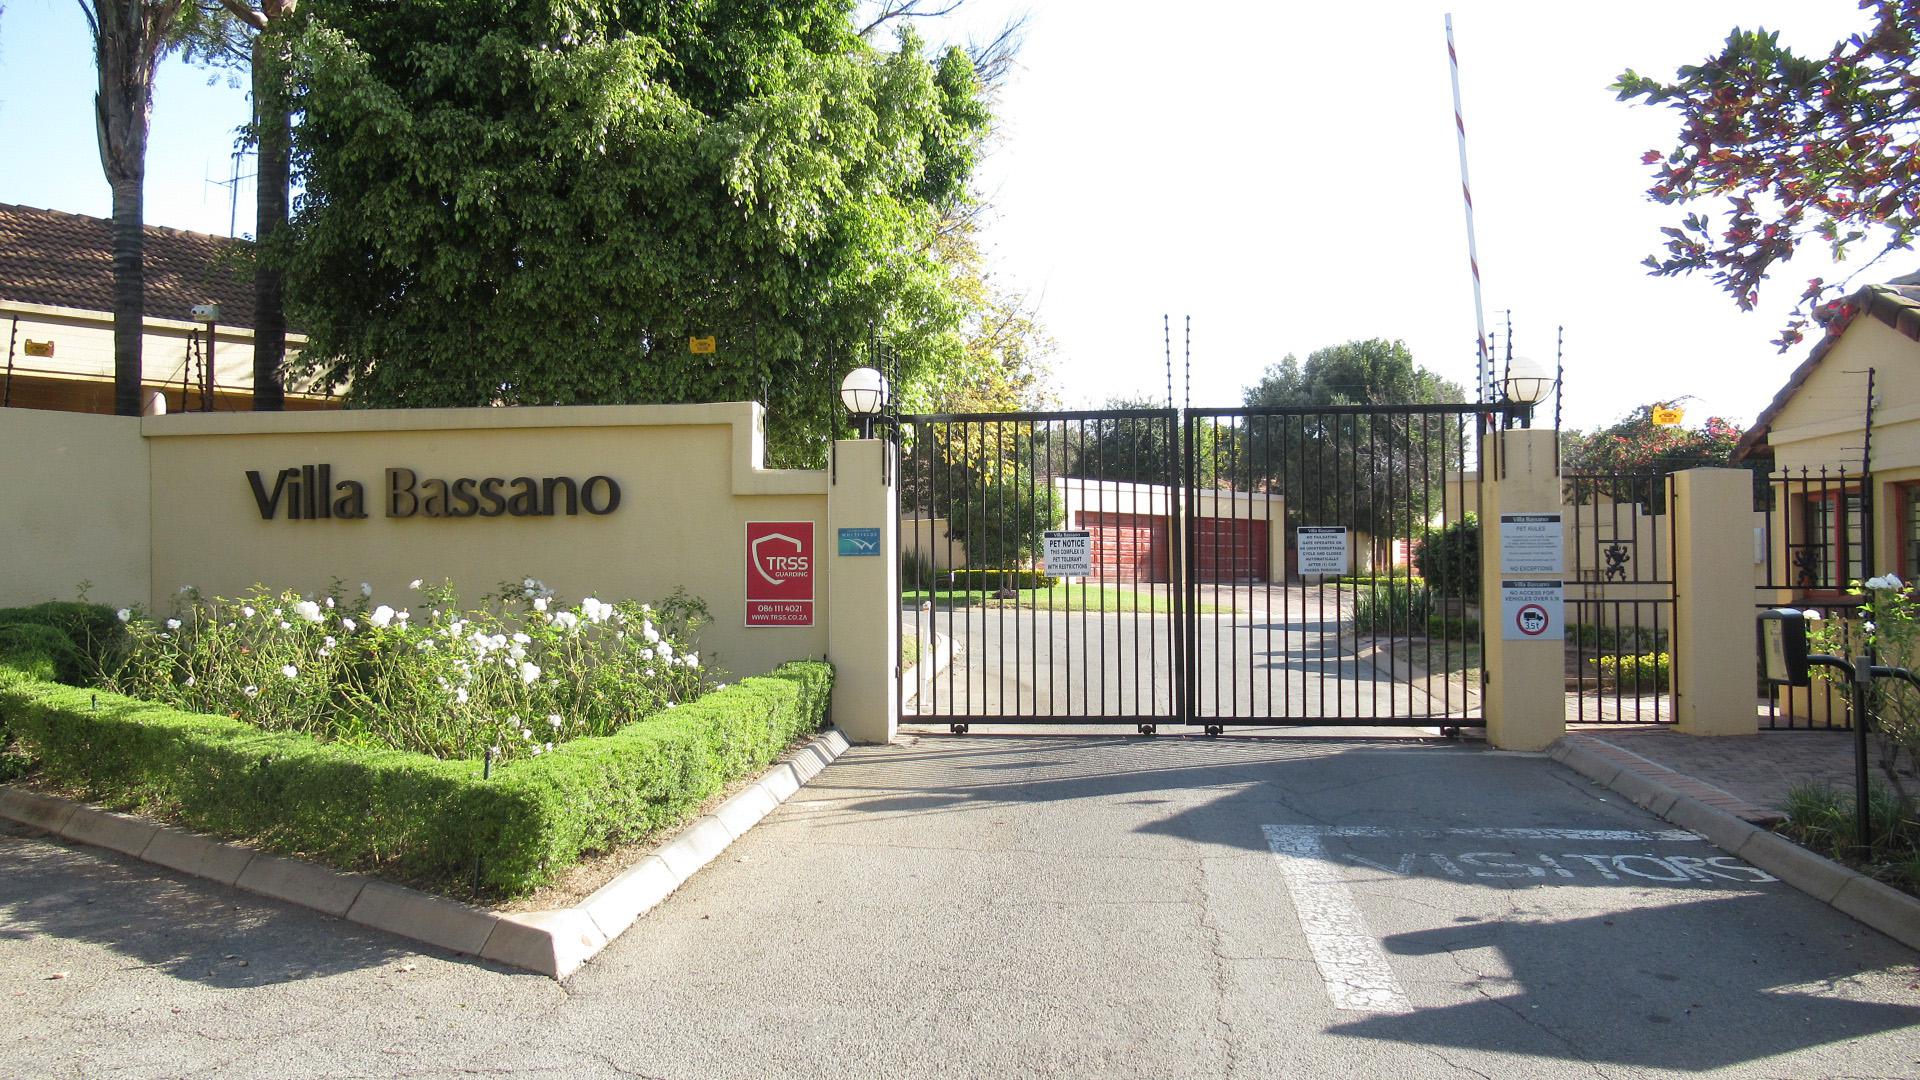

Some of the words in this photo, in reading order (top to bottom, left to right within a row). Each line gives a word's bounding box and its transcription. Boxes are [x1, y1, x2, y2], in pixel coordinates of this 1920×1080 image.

[245, 463, 369, 520] Villa
[385, 467, 621, 518] Bassano
[1049, 540, 1061, 548] PET
[766, 556, 809, 571] TRSS
[758, 604, 773, 612] 086
[774, 604, 784, 612] 111
[784, 604, 802, 612] 4021
[1343, 851, 1779, 882] VISITORS
